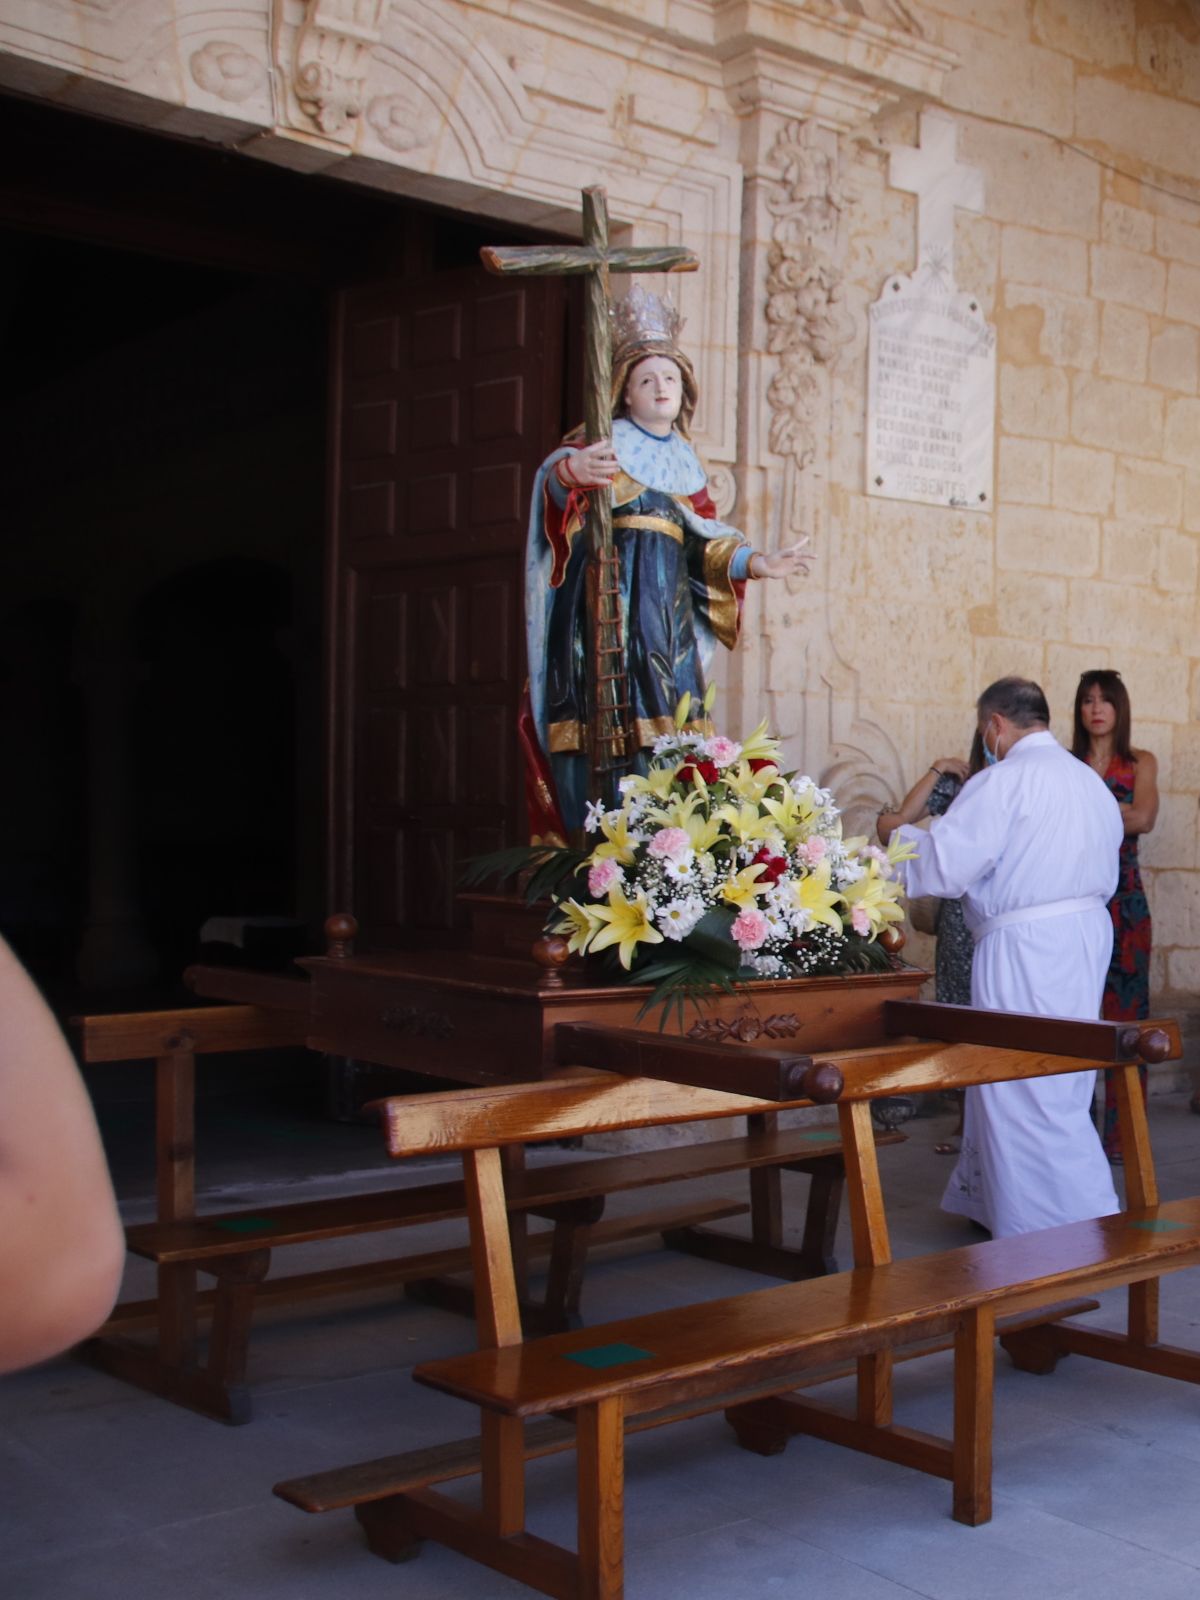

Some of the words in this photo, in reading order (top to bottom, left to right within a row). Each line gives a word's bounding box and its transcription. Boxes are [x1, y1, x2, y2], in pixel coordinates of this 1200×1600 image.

[876, 432, 919, 452] ALFREDO
[929, 426, 962, 444] BENITO
[896, 471, 966, 501] PRESENTES
